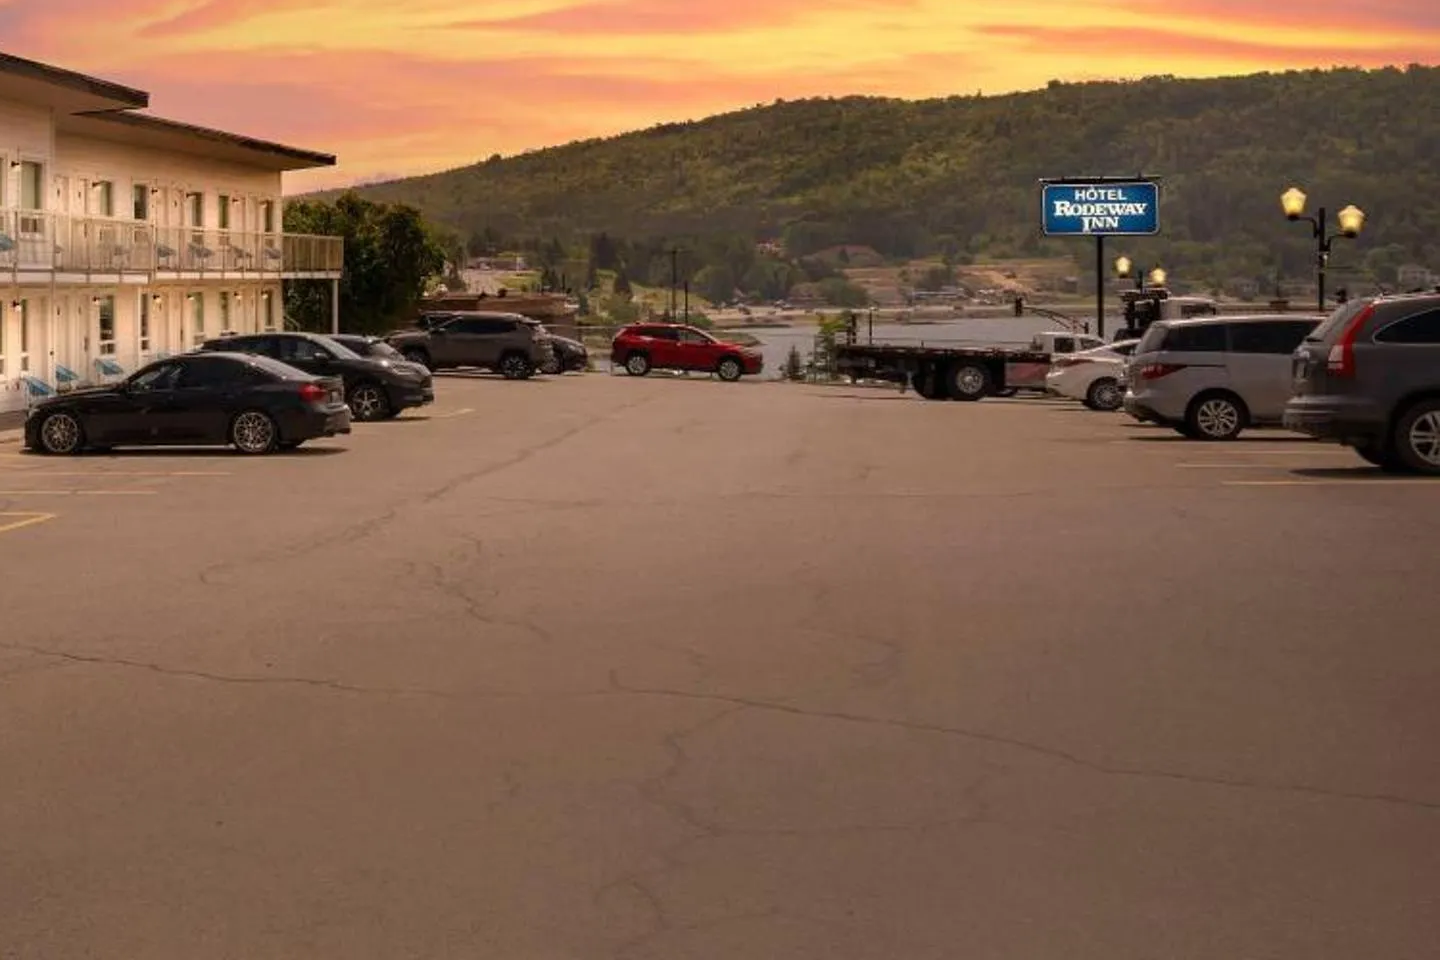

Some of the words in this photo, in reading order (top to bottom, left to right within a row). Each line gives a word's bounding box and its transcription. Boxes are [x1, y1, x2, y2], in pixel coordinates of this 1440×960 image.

[1074, 187, 1127, 200] HÔTEL
[1053, 200, 1148, 216] RODEWAY
[1082, 216, 1119, 233] INN
